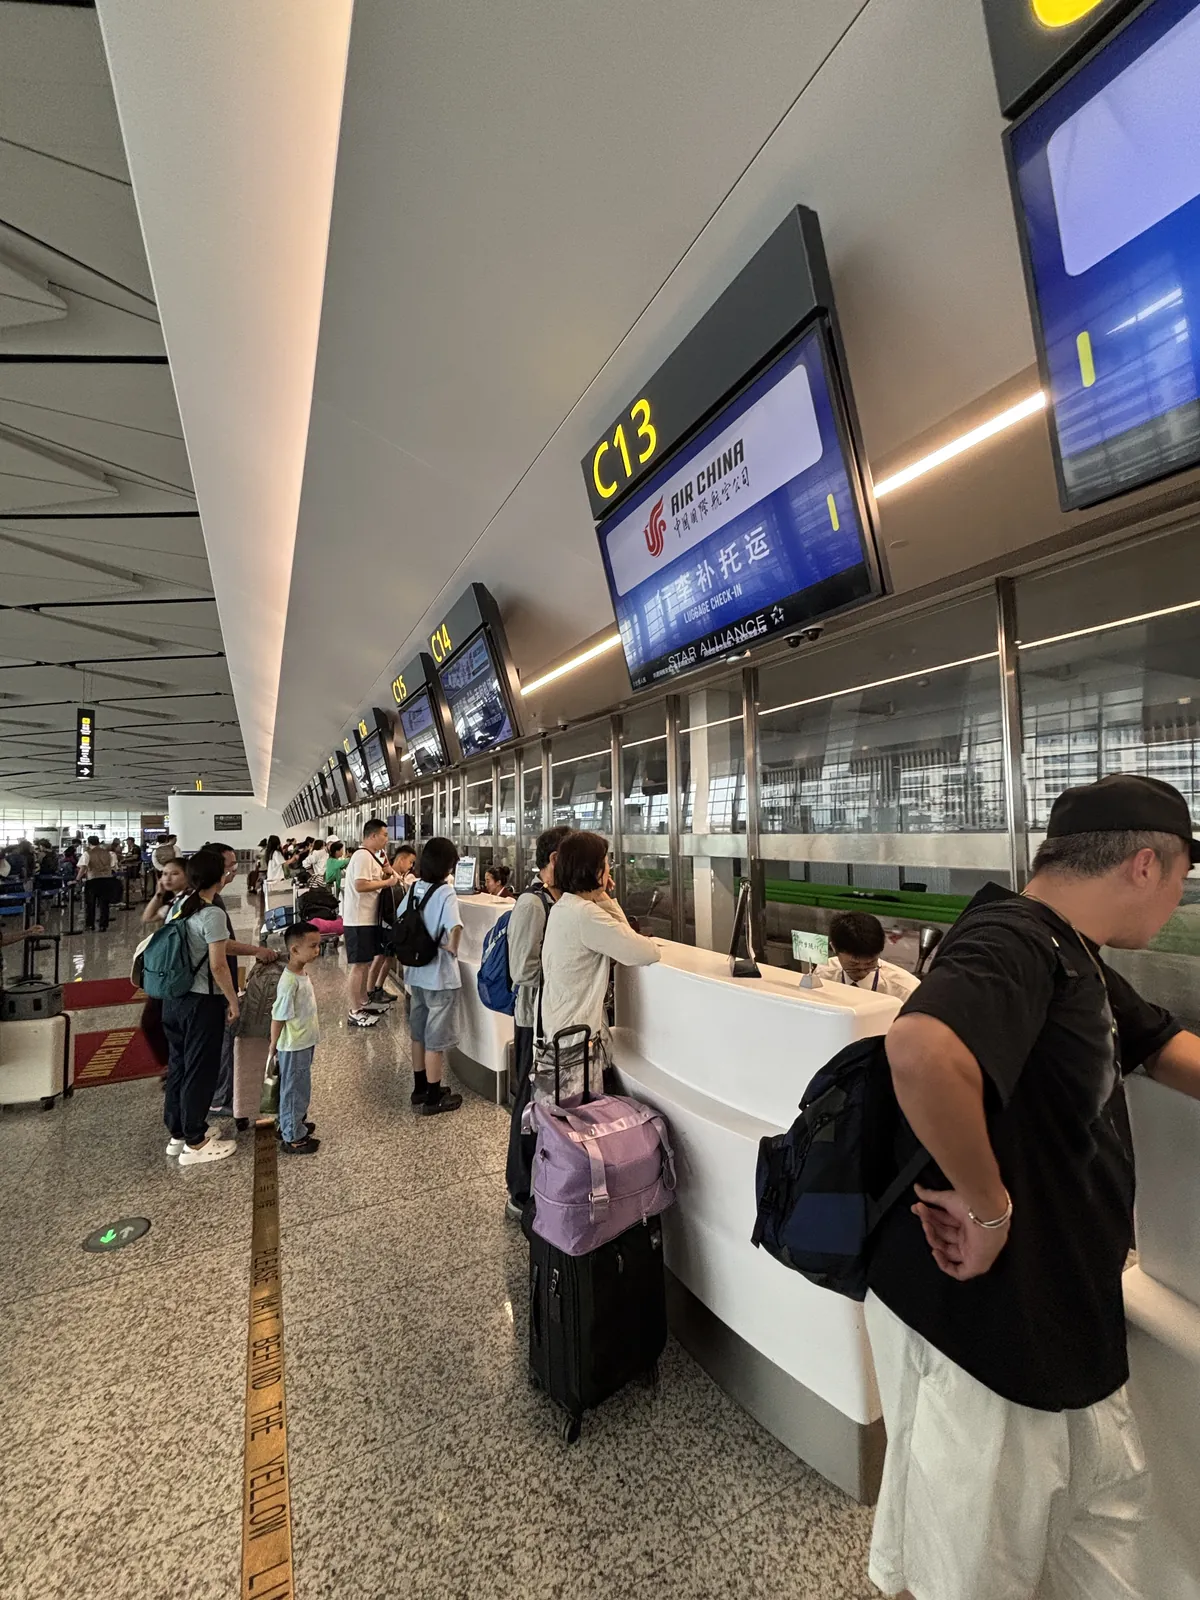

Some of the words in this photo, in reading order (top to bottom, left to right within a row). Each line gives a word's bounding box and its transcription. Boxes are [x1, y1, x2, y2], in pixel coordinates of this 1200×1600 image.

[593, 398, 657, 498] C13
[671, 481, 694, 517] AIR
[696, 438, 744, 496] CHINA
[656, 526, 770, 615] 行李补托运
[683, 600, 711, 624] LUGGAGE
[710, 583, 743, 610] CHECK-IN
[431, 623, 452, 663] C14
[668, 647, 697, 668] STAR
[700, 614, 766, 656] ALLIANCE
[392, 674, 407, 703] C15
[76, 1047, 127, 1079] CHINA
[254, 1247, 278, 1287] PLEASE
[252, 1292, 280, 1325] WAIT
[251, 1333, 282, 1391] BEHIND
[251, 1400, 283, 1442] THE
[249, 1452, 287, 1541] YELLOW
[248, 1559, 290, 1600] LI
